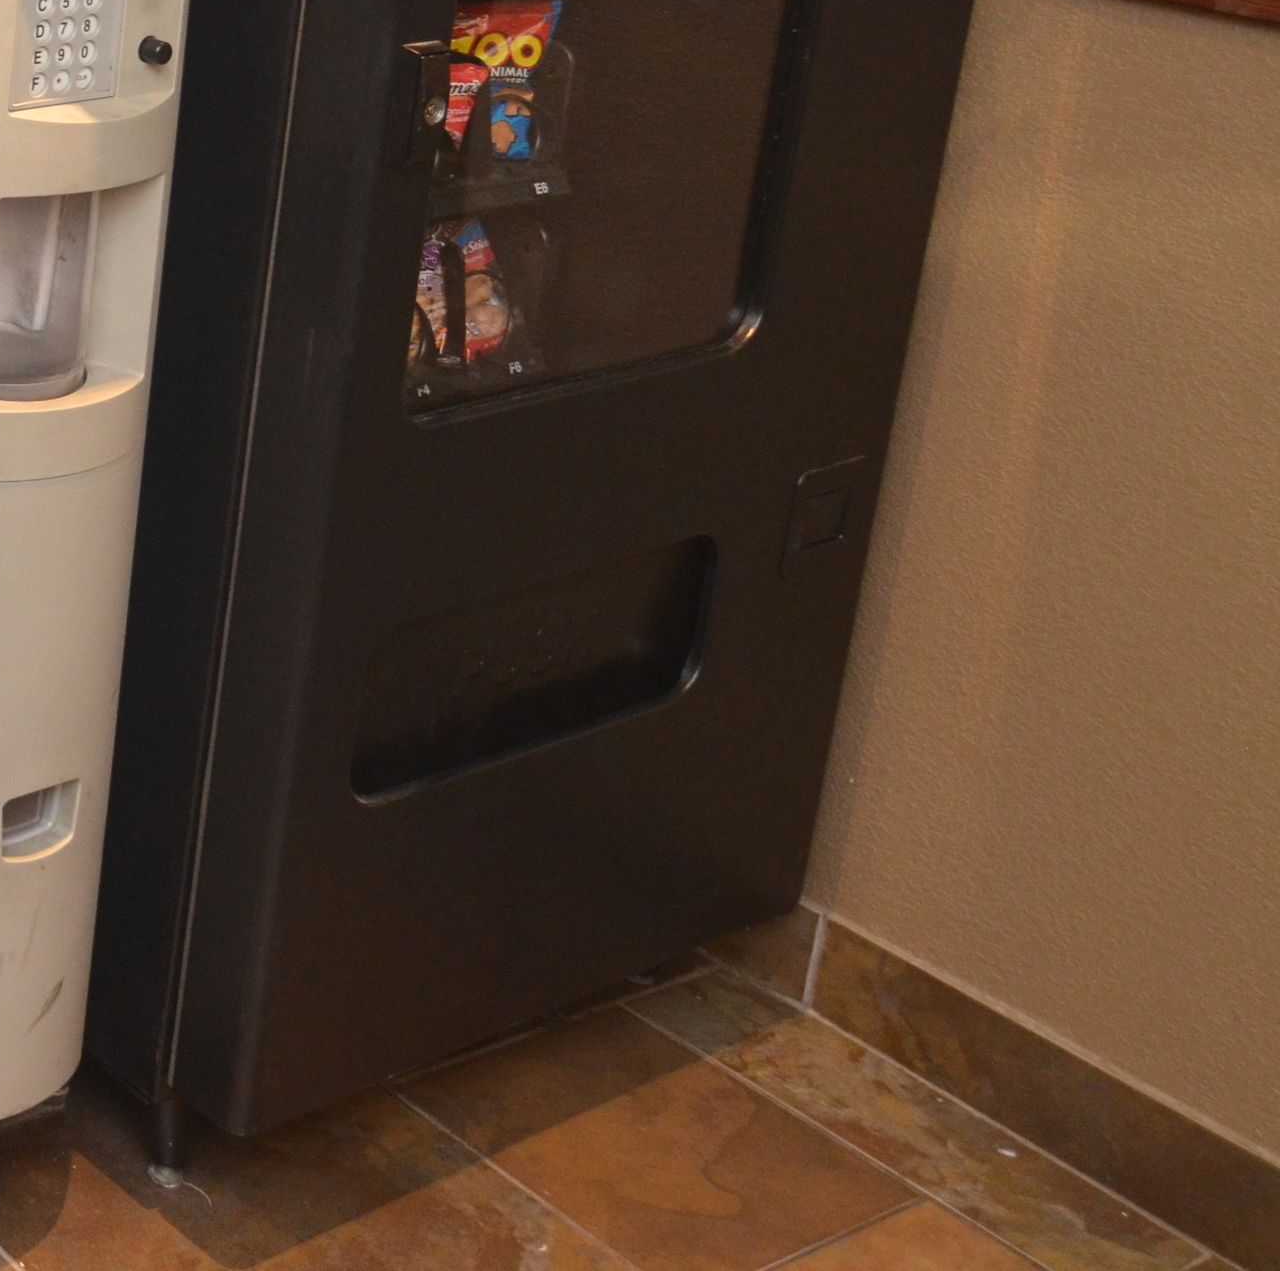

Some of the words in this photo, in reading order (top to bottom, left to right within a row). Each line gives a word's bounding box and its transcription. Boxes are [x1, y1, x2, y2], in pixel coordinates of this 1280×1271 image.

[35, 24, 45, 38] D
[59, 22, 68, 35] 7
[83, 19, 91, 32] 8
[33, 50, 42, 64] E
[57, 48, 65, 61] 9
[80, 45, 89, 58] 0
[490, 66, 529, 79] NIMAL
[31, 77, 40, 91] F
[534, 181, 549, 195] E6
